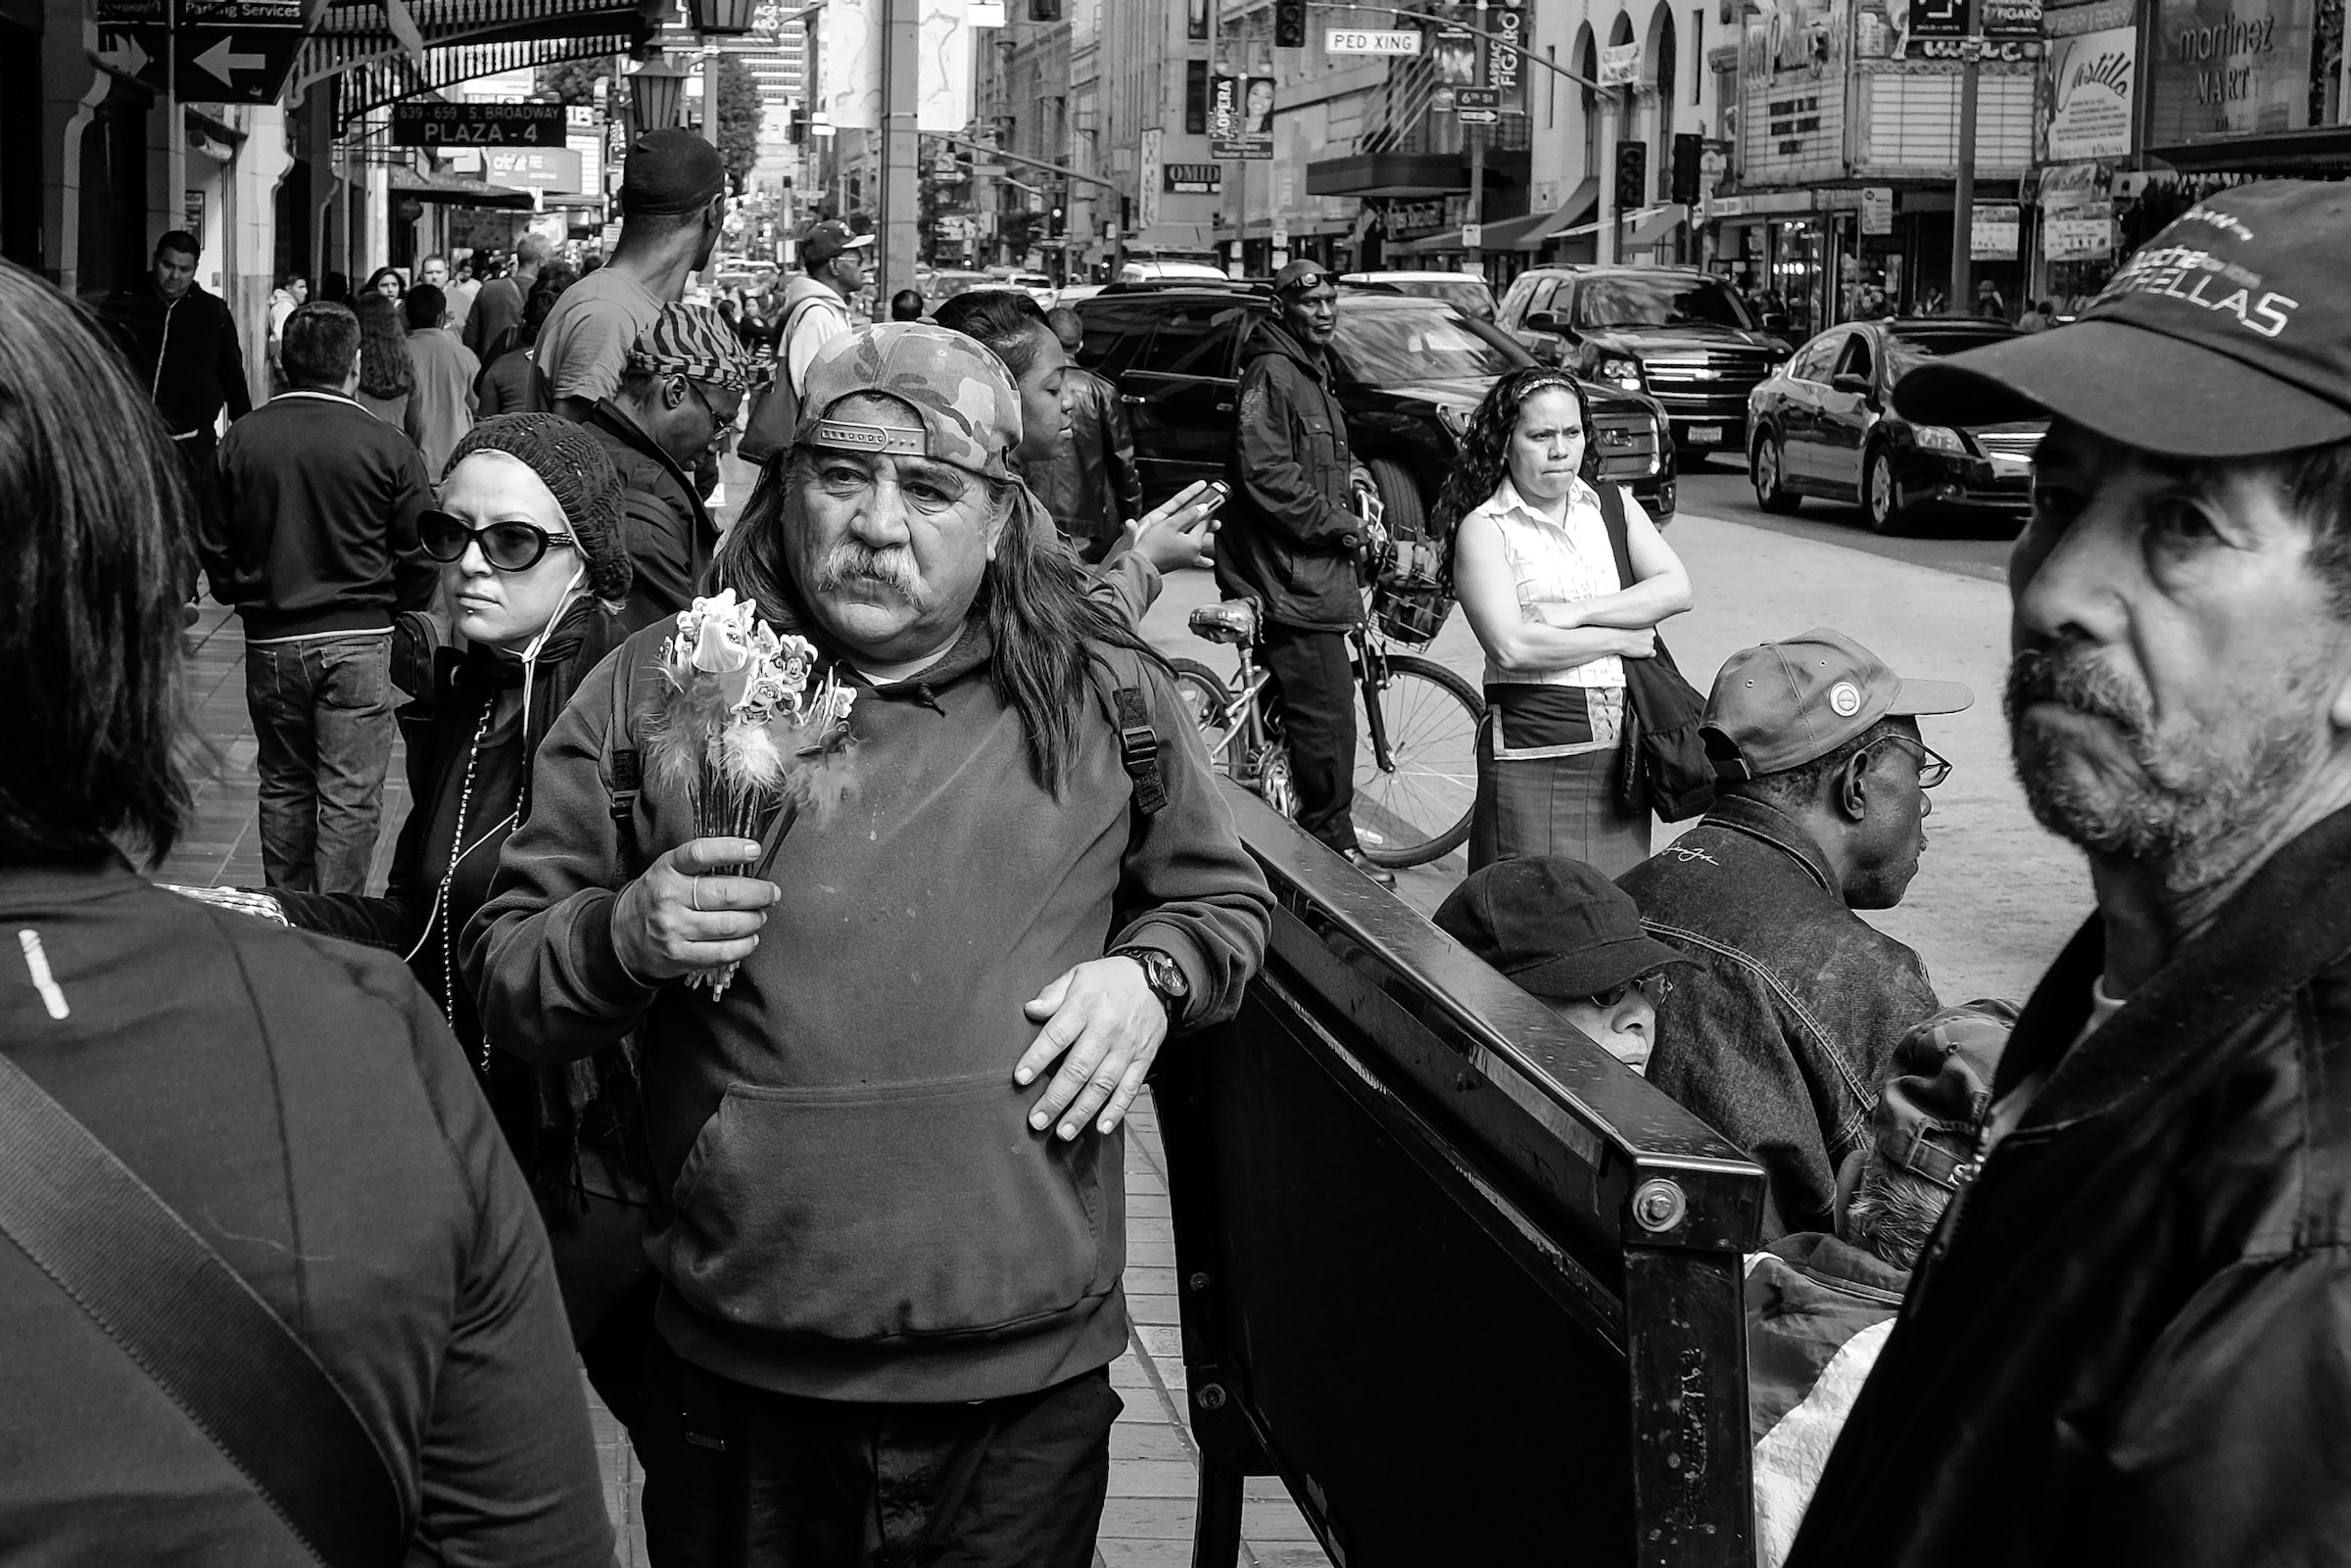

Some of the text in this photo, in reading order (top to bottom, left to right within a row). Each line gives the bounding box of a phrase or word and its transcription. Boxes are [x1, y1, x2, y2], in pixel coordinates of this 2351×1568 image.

[185, 2, 301, 18] Parkng Services
[1333, 34, 1413, 50] PED XING
[2180, 13, 2275, 62] martinez
[1501, 13, 1519, 87] FIGARO
[2057, 40, 2132, 113] Castillo
[400, 106, 423, 119] 639
[434, 107, 457, 119] 659
[468, 106, 482, 119] S.
[485, 107, 559, 119] BROADWAY
[424, 123, 504, 142] PLAZA
[524, 123, 538, 142] 4
[1169, 165, 1221, 182] OMID
